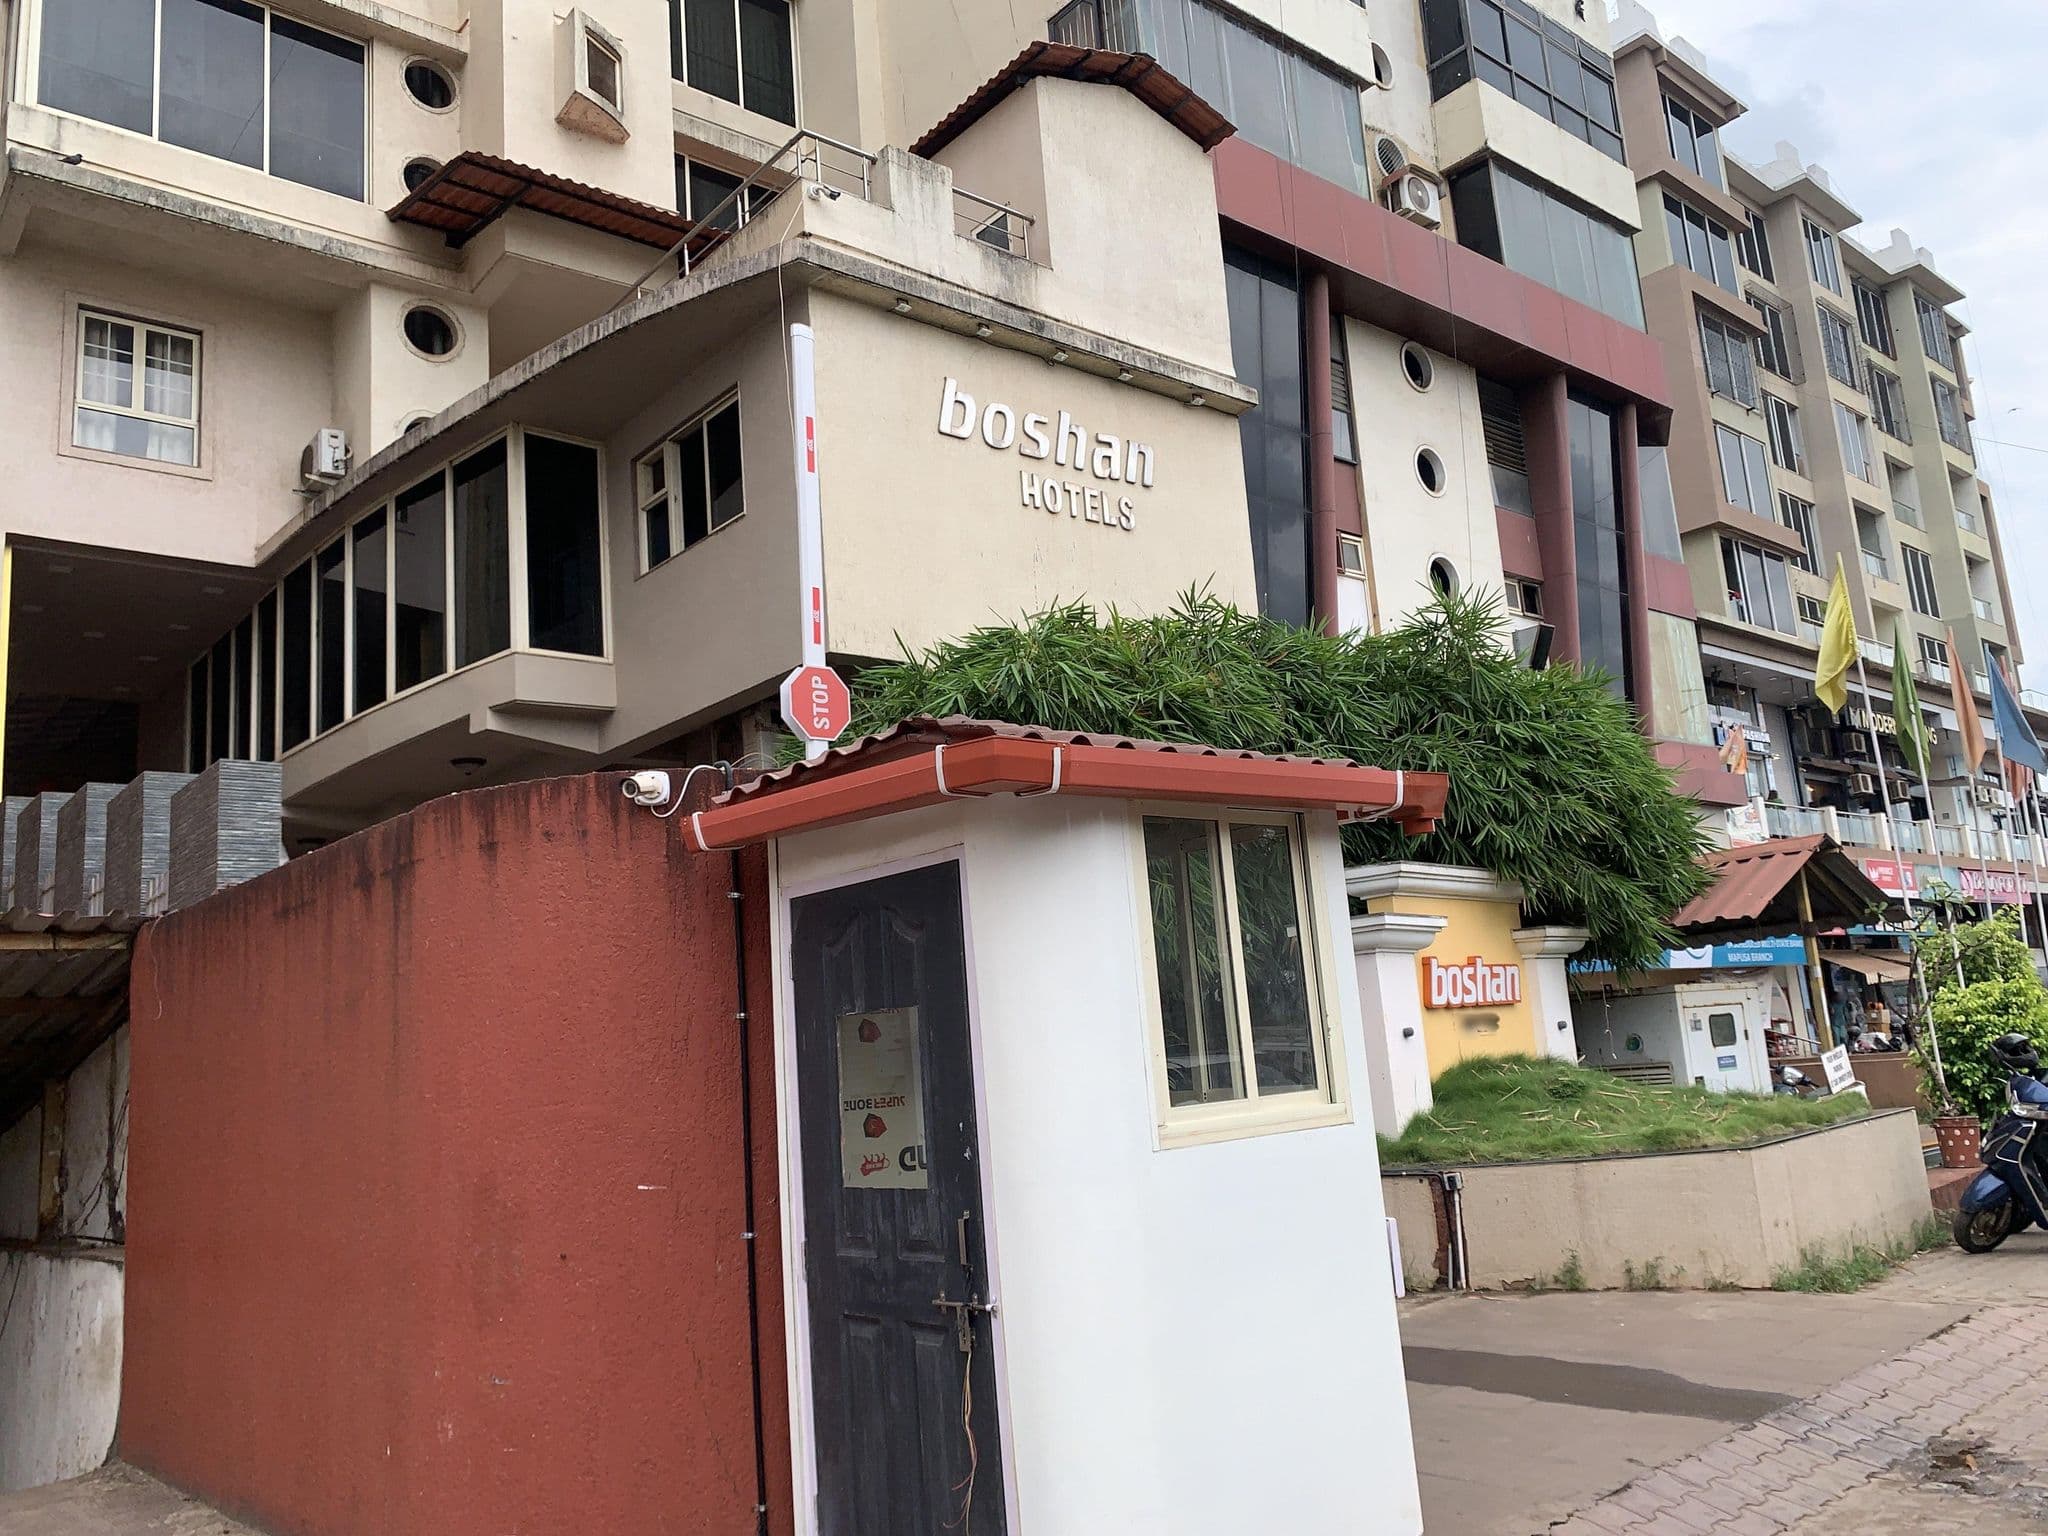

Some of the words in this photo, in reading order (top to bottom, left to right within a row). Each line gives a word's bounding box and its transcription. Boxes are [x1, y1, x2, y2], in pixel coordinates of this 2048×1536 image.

[938, 376, 1154, 487] boshan
[1019, 470, 1136, 531] HOTELS
[811, 675, 830, 730] STOP
[1429, 956, 1521, 1007] boshan
